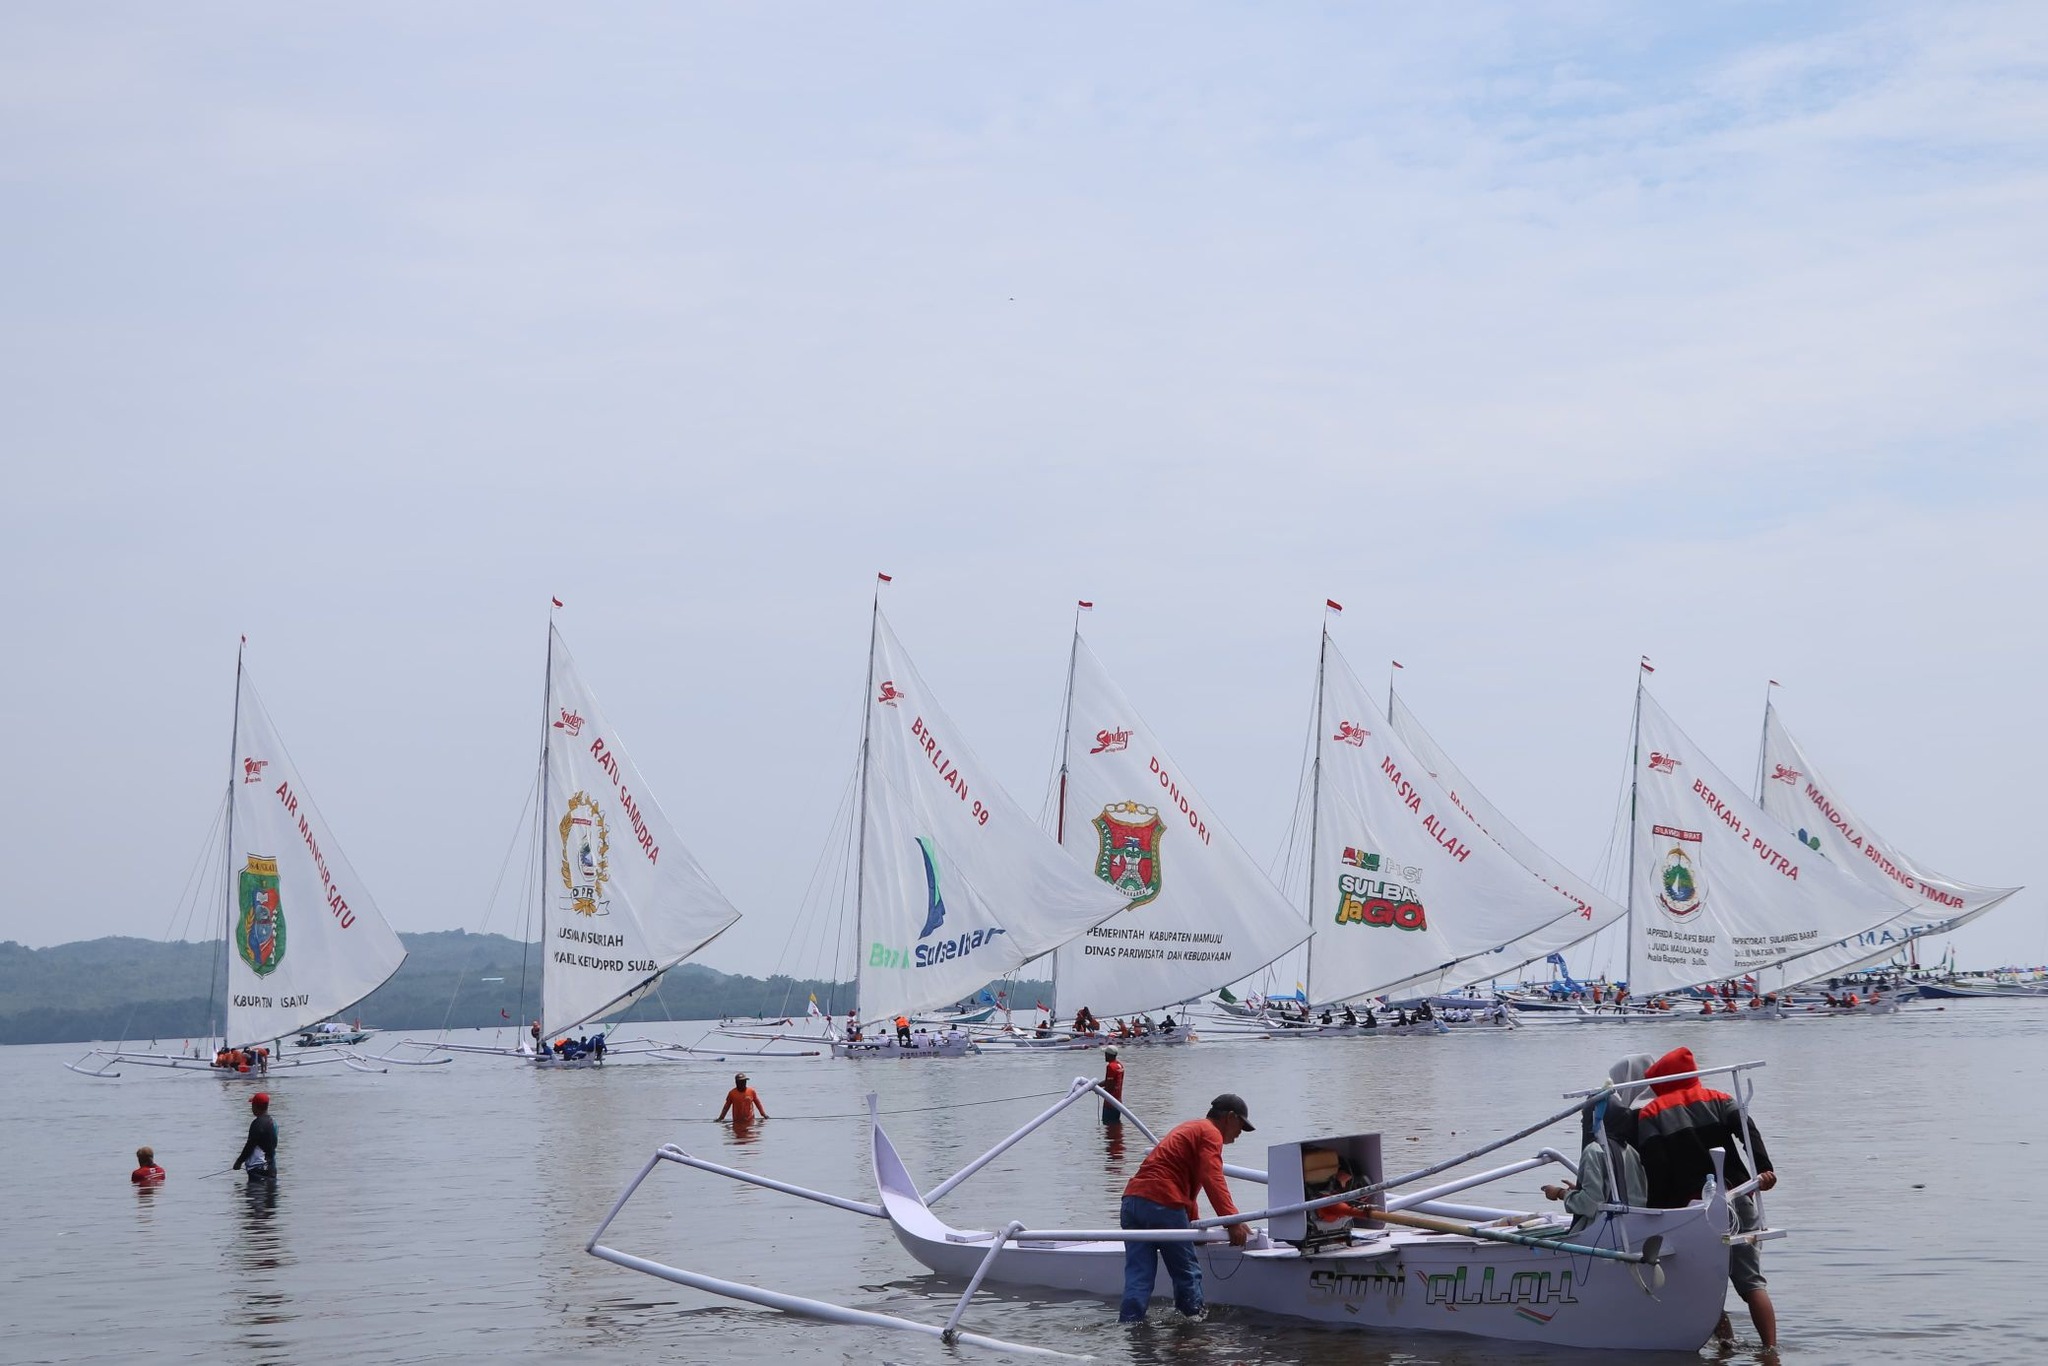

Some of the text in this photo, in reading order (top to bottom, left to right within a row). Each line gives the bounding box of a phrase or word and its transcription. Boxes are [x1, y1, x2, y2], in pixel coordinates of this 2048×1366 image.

[590, 737, 660, 866] RATU SAMUDRA
[911, 716, 989, 826] BERLIAN 99
[1149, 756, 1210, 845] DONDORI
[1381, 755, 1422, 814] MASYA
[1422, 814, 1471, 862] ALLAH
[276, 781, 356, 929] AIR MANCUR SATU
[1692, 778, 1800, 881] BERKAH 2 PUTRA
[1804, 783, 1966, 909] MANDALA BINTANG TIMUR
[1084, 945, 1232, 962] DINAS PARIWISATA DAN KEBUDAYAAN
[1086, 926, 1223, 944] PEMERINTAH KABUPATEN MAMUJU
